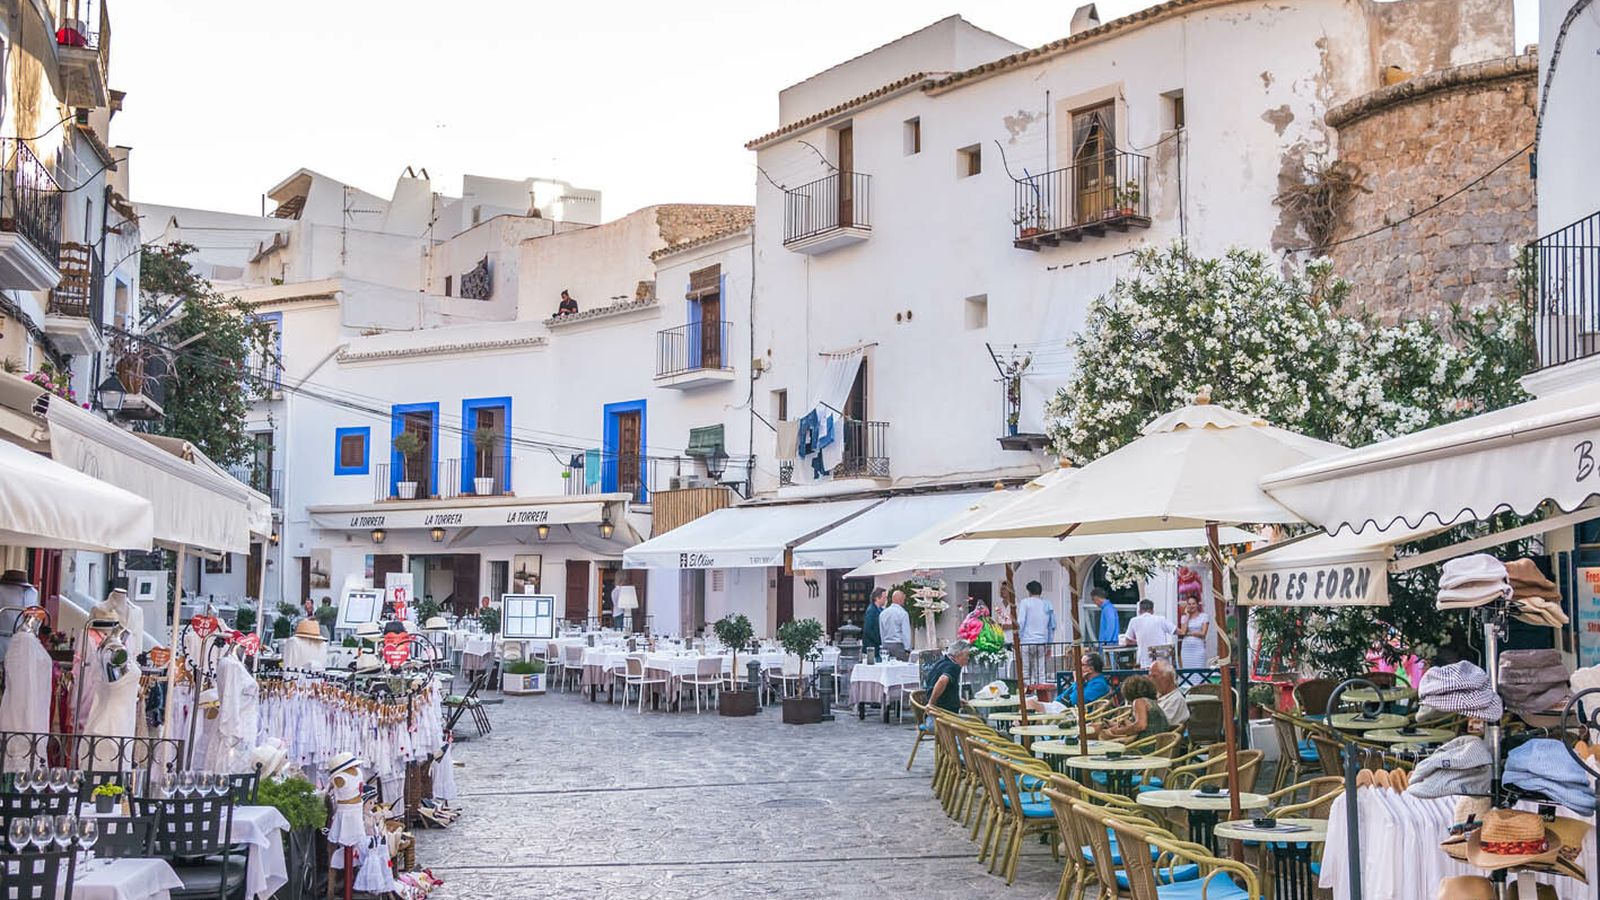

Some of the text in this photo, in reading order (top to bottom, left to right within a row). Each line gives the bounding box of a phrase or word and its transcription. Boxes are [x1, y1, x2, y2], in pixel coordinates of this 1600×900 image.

[1574, 440, 1600, 482] B
[350, 516, 385, 526] LA TORRETA
[424, 513, 462, 525] LA TORRETA
[506, 511, 548, 523] LA TORRETA
[698, 554, 715, 566] Olivo
[1247, 567, 1370, 600] BAR ES FORN
